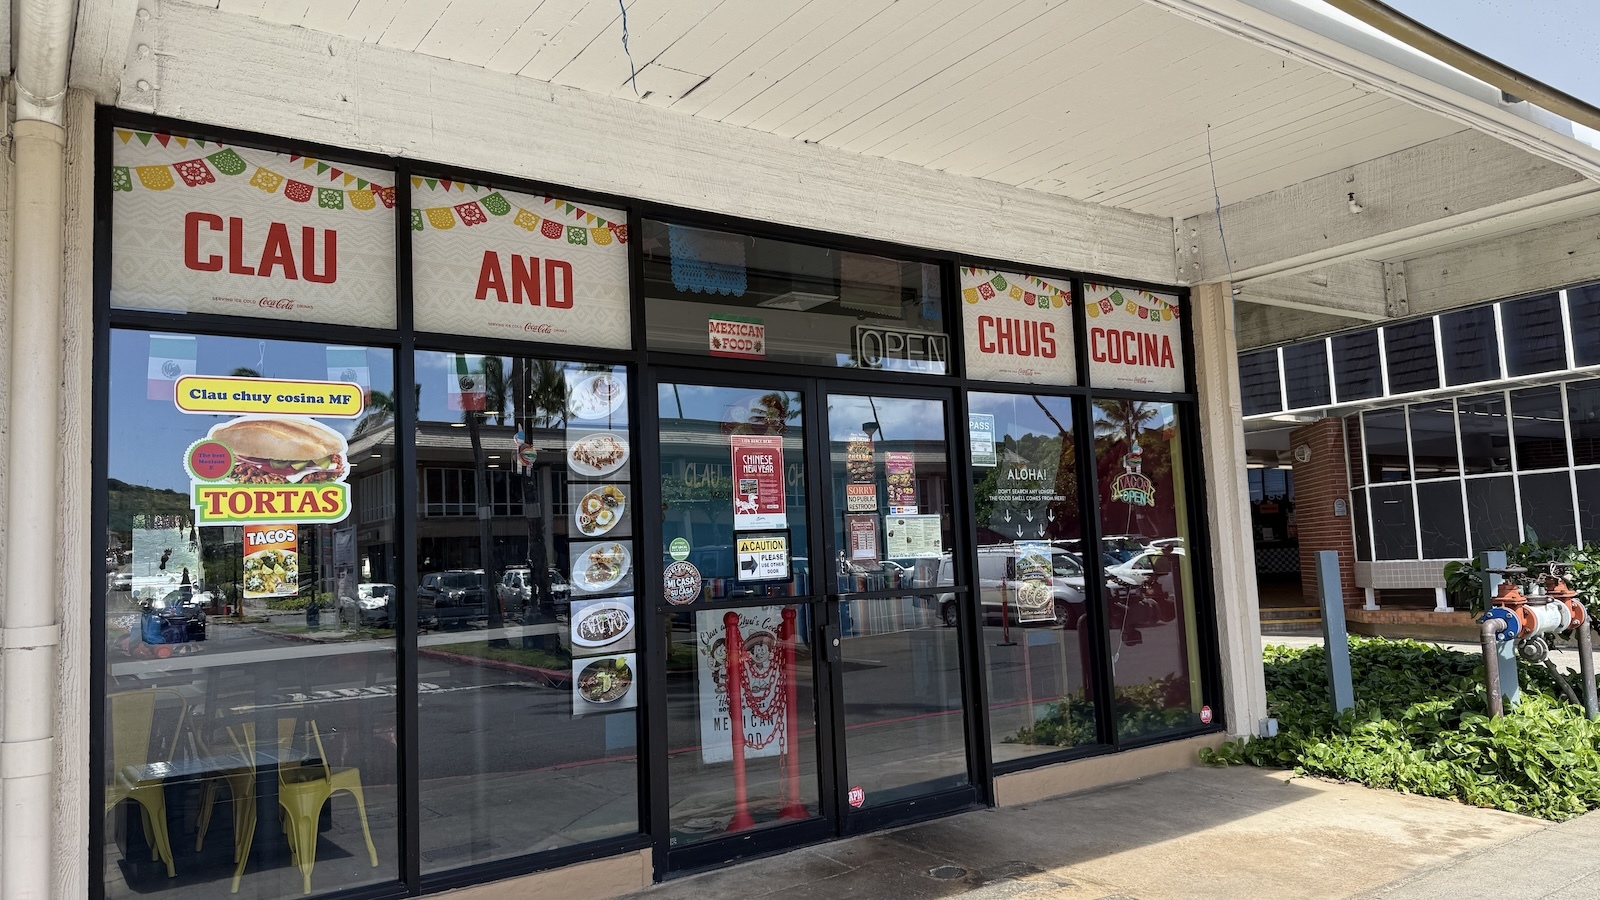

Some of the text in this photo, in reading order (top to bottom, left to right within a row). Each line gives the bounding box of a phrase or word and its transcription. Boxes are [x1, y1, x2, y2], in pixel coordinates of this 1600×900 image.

[184, 211, 337, 284] CLAU
[475, 250, 574, 310] AND
[709, 321, 764, 338] MEXICAN
[977, 315, 1057, 359] CHUIS
[722, 338, 753, 350] FOOD
[861, 330, 946, 370] OPEN
[1090, 327, 1175, 369] COCINA
[189, 389, 352, 405] Clau chuy cosina MF
[970, 421, 990, 430] PASS
[742, 455, 773, 465] CHINESE
[684, 463, 721, 488] CLAU
[743, 465, 774, 473] NEW YEAR
[1007, 468, 1047, 480] ALOHA!
[848, 485, 874, 495] SORRY
[1120, 476, 1149, 492] TACOS
[204, 490, 339, 515] TORTAS
[1123, 490, 1146, 506] OPEN
[246, 529, 296, 545] TACOS
[749, 540, 784, 551] CAUTION
[760, 553, 784, 561] PLEASE
[667, 564, 694, 578] WELCOME
[667, 576, 695, 588] MI CASA
[678, 587, 694, 596] CASA
[700, 628, 718, 646] Clau
[713, 715, 774, 731] MEICAN
